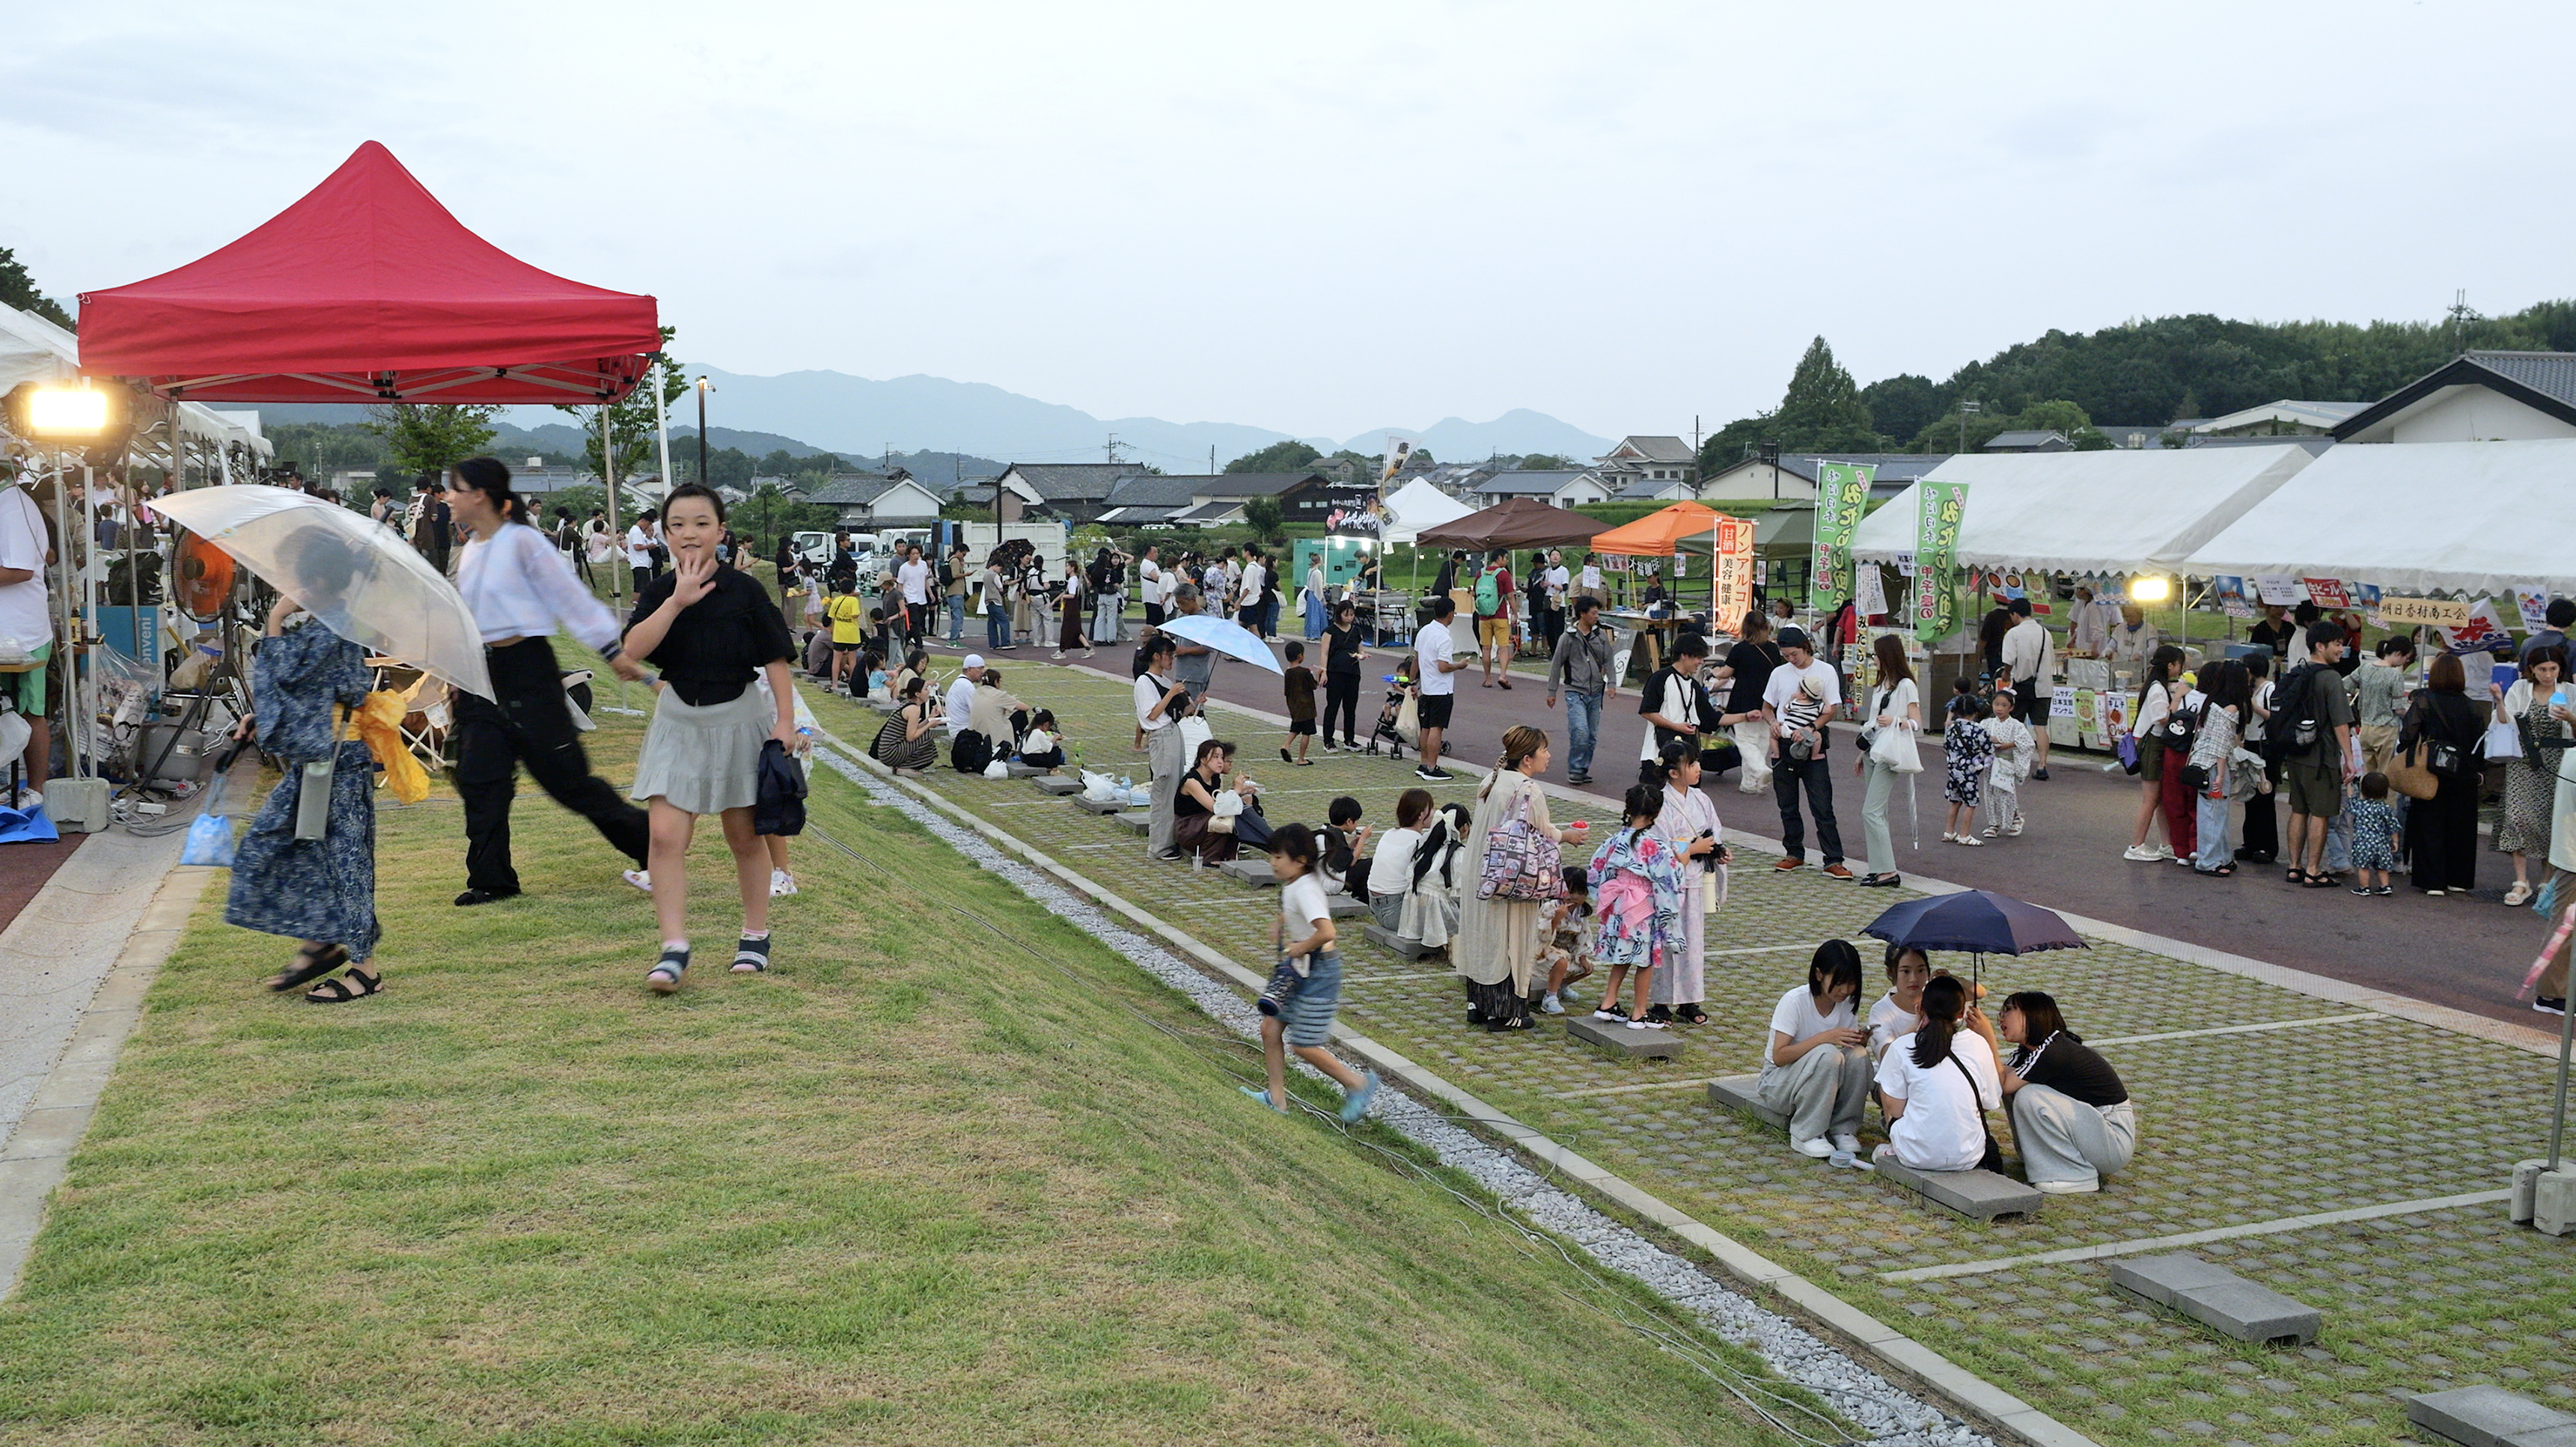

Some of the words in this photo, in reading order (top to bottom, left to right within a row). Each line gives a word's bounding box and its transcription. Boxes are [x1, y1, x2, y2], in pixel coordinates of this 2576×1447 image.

[1723, 528, 1736, 551] 甘酒
[1722, 557, 1733, 581] 美容
[1727, 524, 1751, 634] ノンアルコール
[1721, 583, 1733, 606] 健康
[2307, 581, 2345, 596] 生ビール!
[2381, 602, 2466, 620] 明日香村商工会
